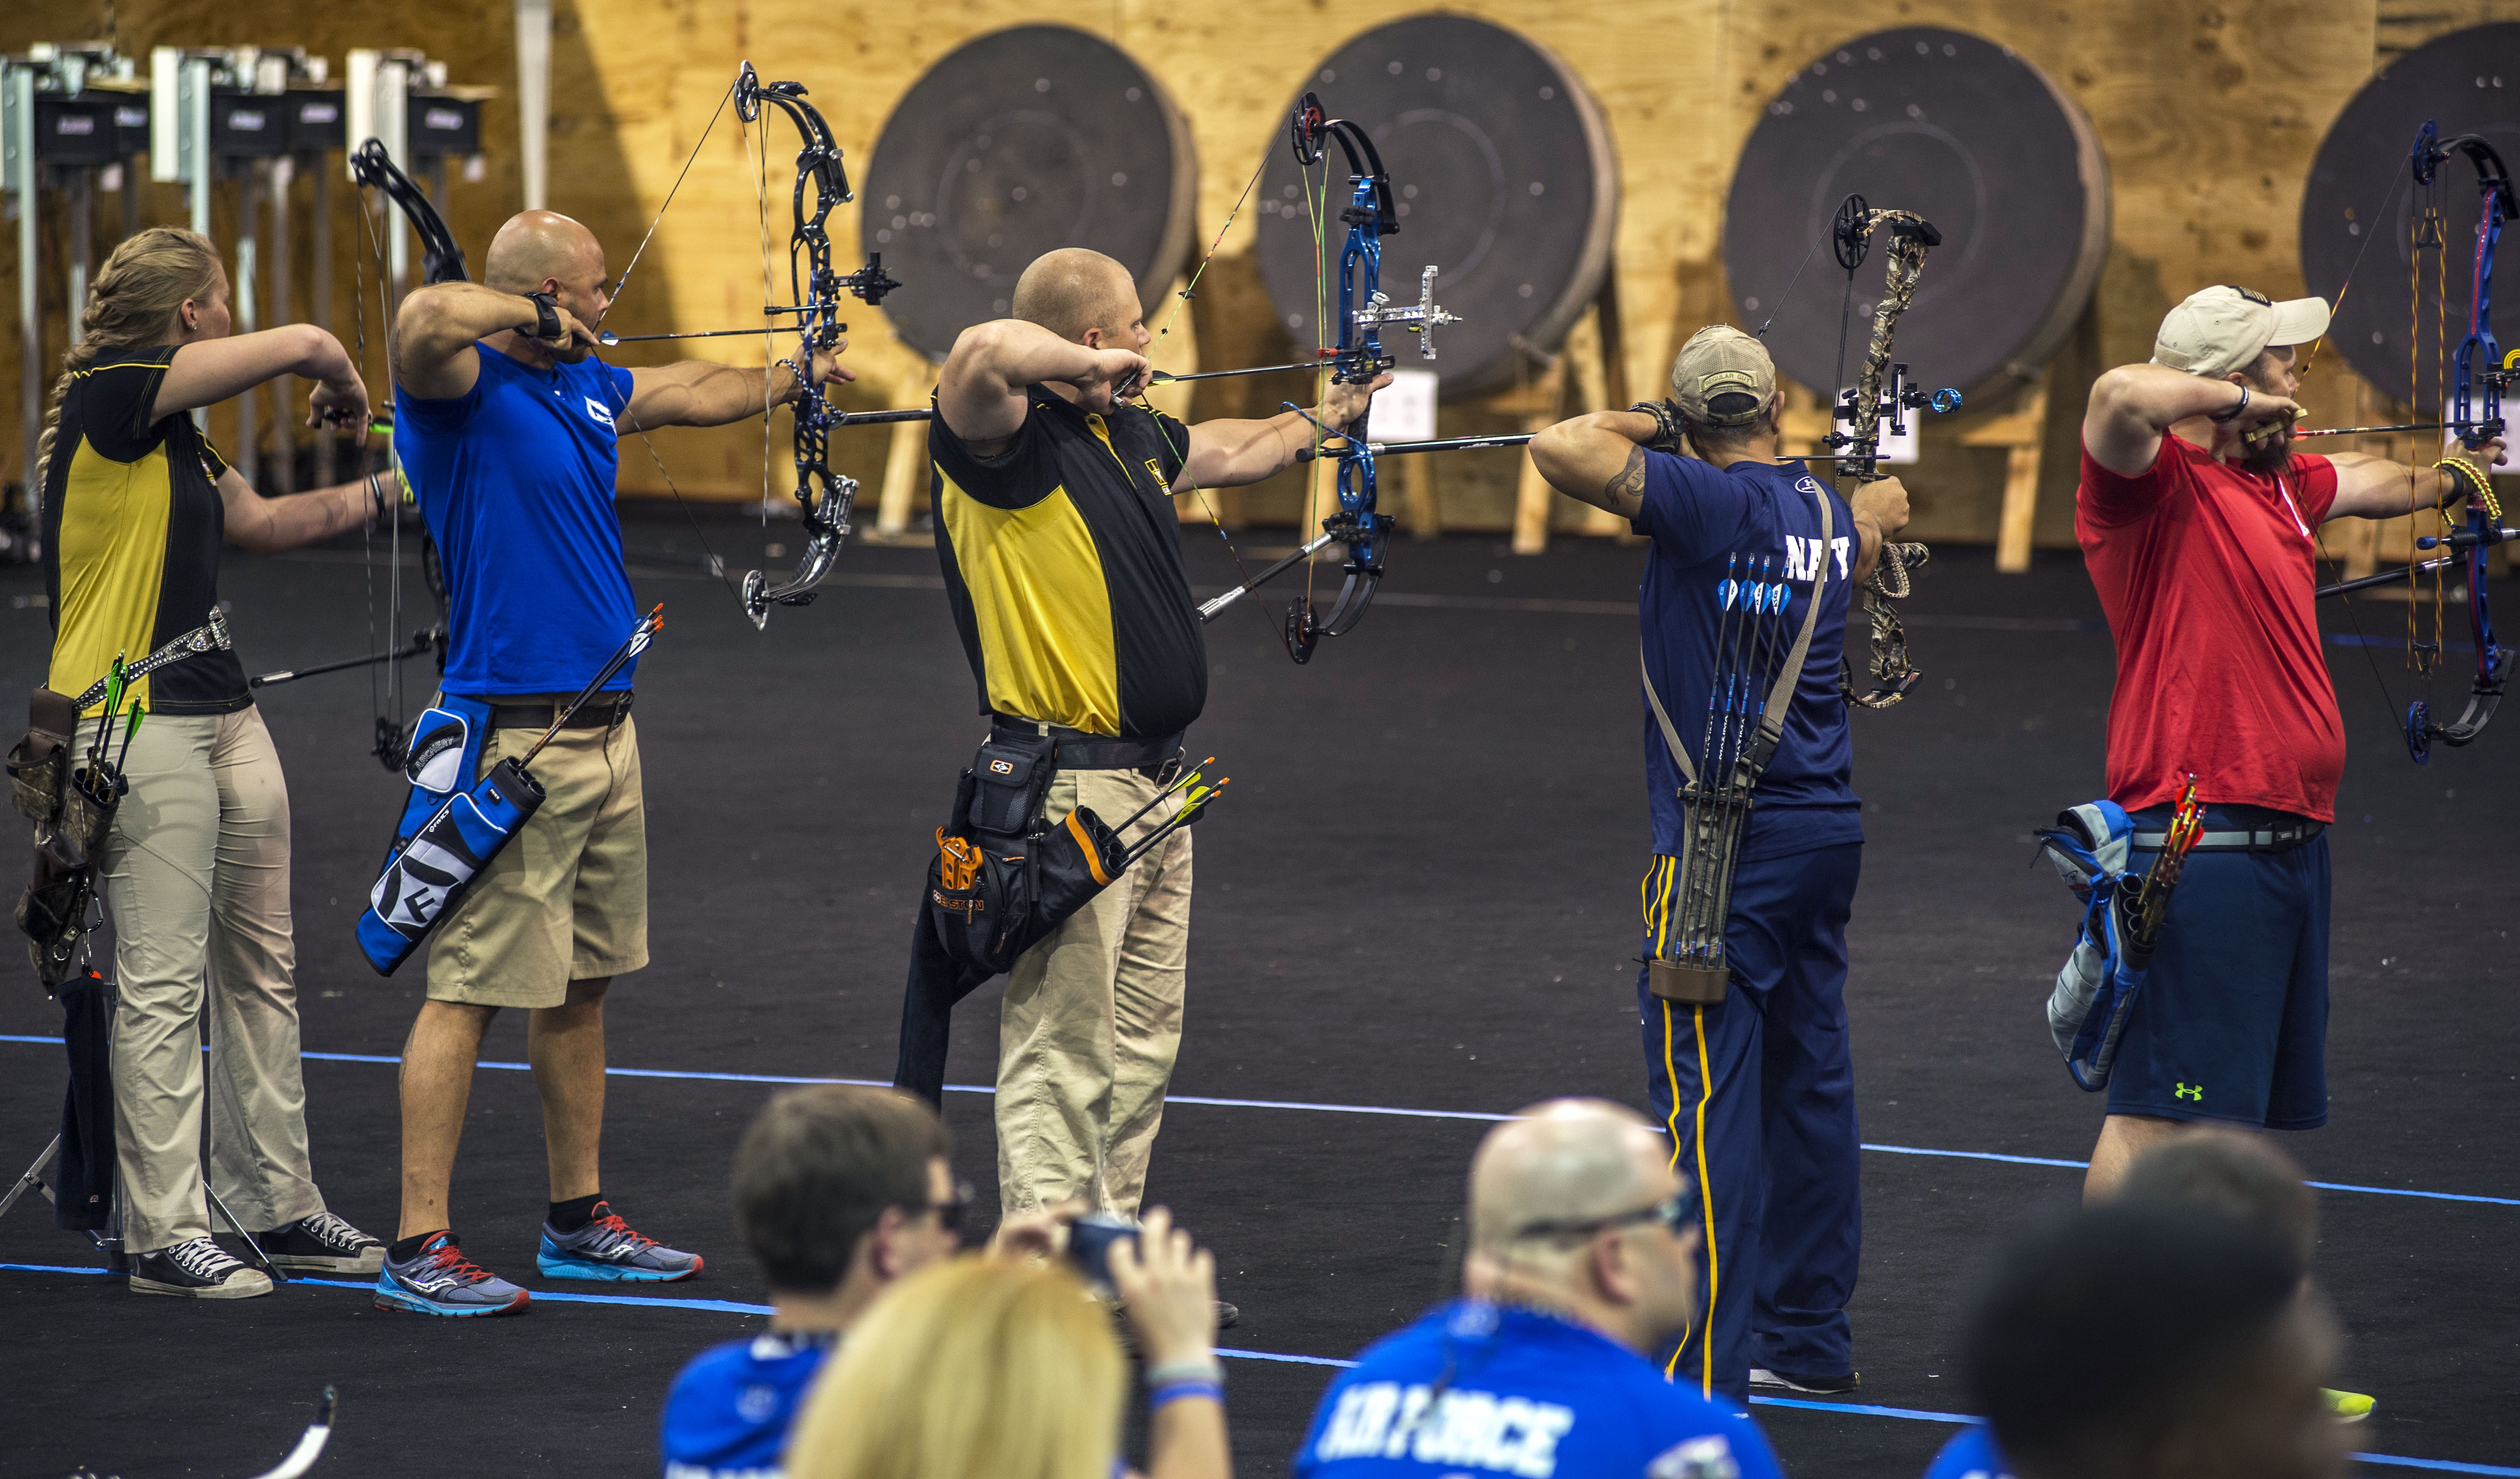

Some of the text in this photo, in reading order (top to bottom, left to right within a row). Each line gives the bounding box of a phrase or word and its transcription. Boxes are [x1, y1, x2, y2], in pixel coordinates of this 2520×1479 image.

[1705, 373, 1750, 386] REGULAR GUY
[1782, 535, 1850, 582] NAY
[415, 736, 454, 771] ARCHERY
[1719, 715, 1729, 760] MAXIMA
[1735, 718, 1745, 762] MAXIMA
